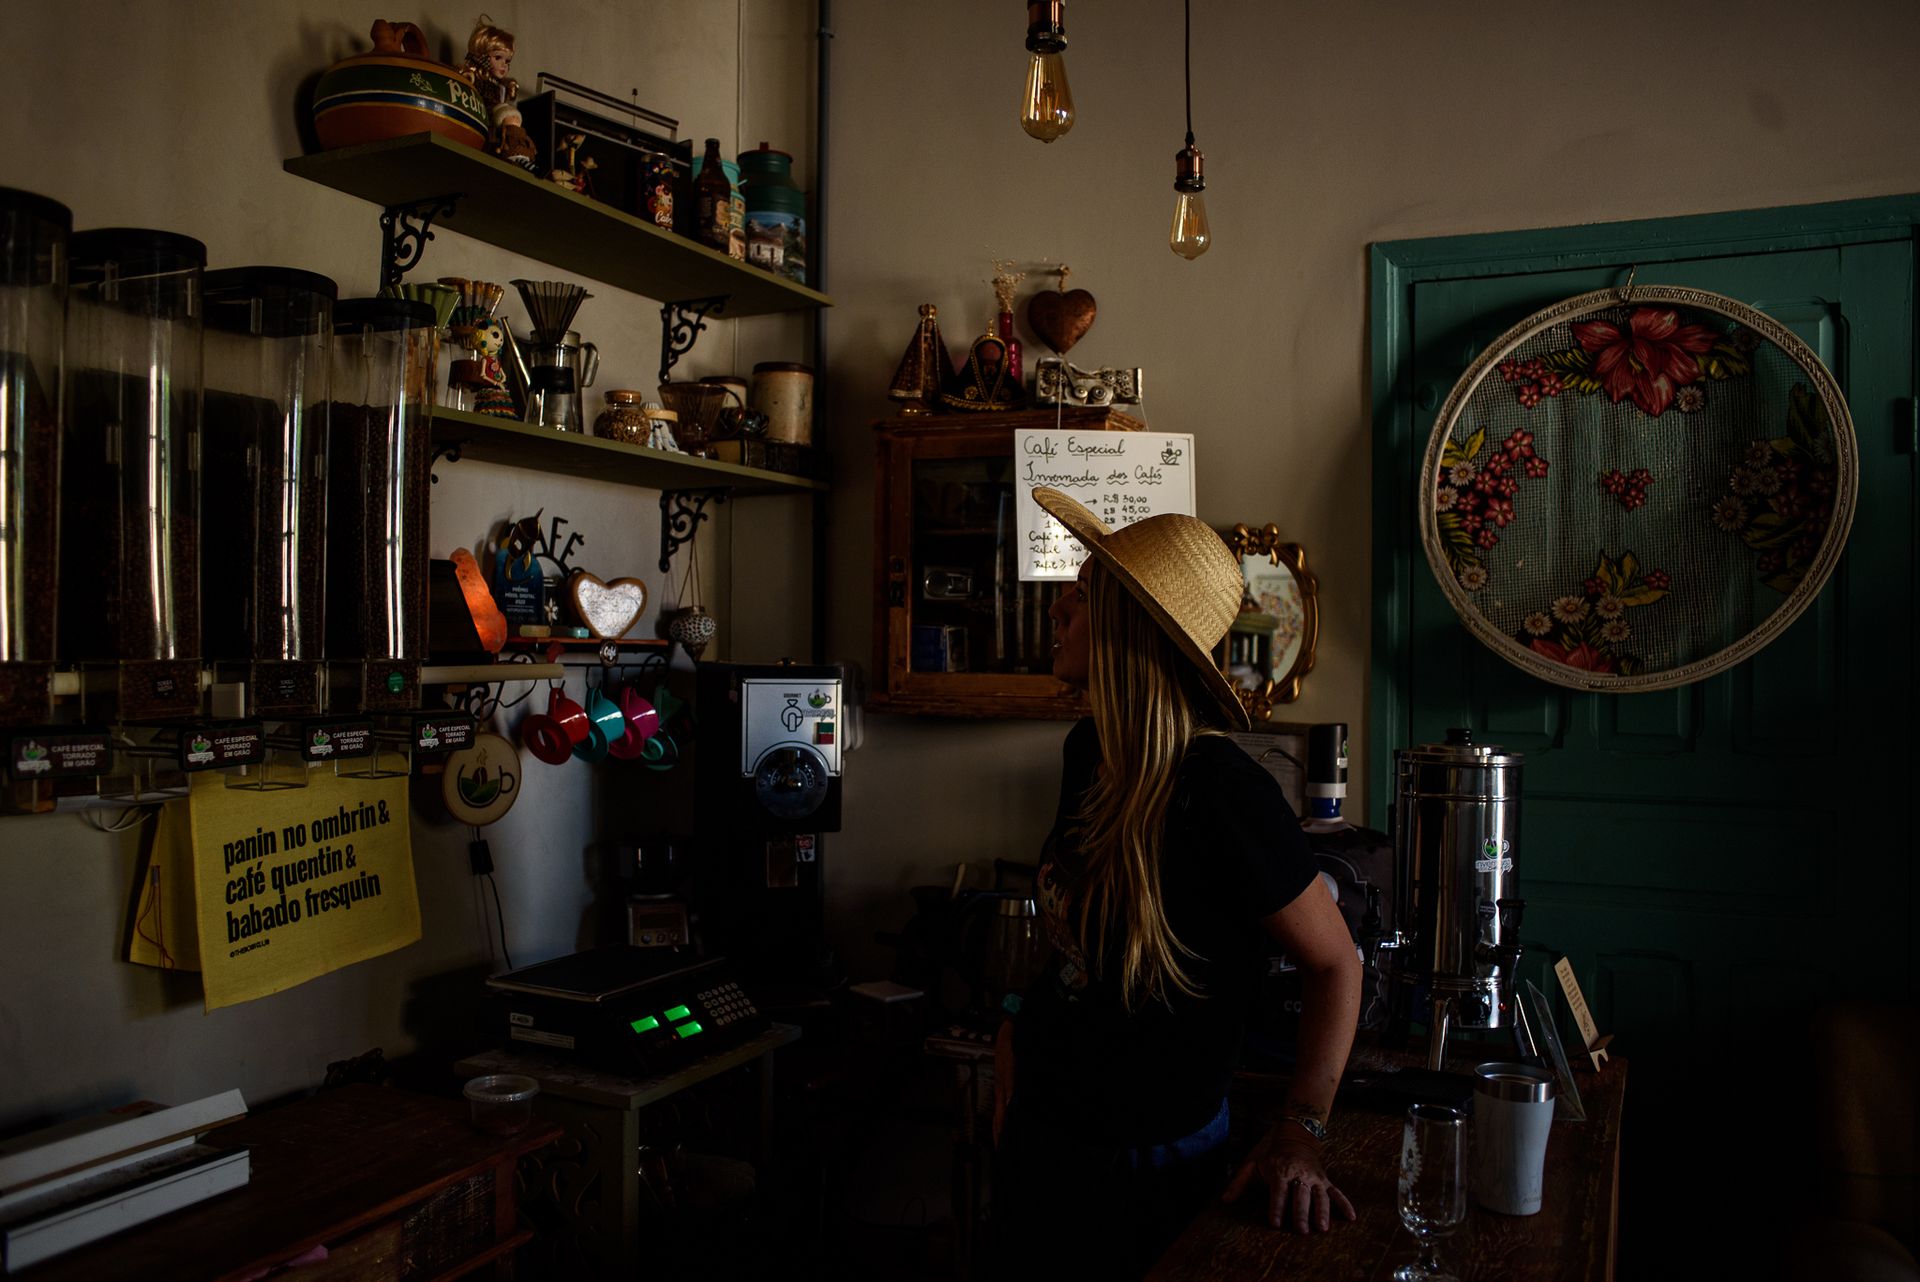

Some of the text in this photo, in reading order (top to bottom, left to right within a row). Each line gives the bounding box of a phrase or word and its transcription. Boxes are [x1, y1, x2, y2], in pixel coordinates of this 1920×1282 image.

[1024, 435, 1125, 464] Café Especial
[1106, 469, 1128, 480] dos
[1134, 464, 1162, 482] Cafés
[1103, 494, 1147, 505] R$ 30,00
[1104, 505, 1150, 515] R$ 45,00
[1029, 530, 1052, 545] Café
[214, 734, 259, 746] CAFÉ ESPECIAL
[333, 730, 370, 739] CAFÉ ESPECIAL
[51, 743, 104, 752] CAFÉ ESPECIAL
[223, 741, 251, 751] TORRADO
[237, 747, 251, 756] GRÃO
[62, 752, 96, 760] TORRADO
[62, 760, 77, 768] EM
[79, 758, 96, 768] GRÃO
[223, 800, 391, 874] panin no ombrin &
[225, 844, 357, 905] café quentin &
[226, 871, 382, 943] babado fresquin
